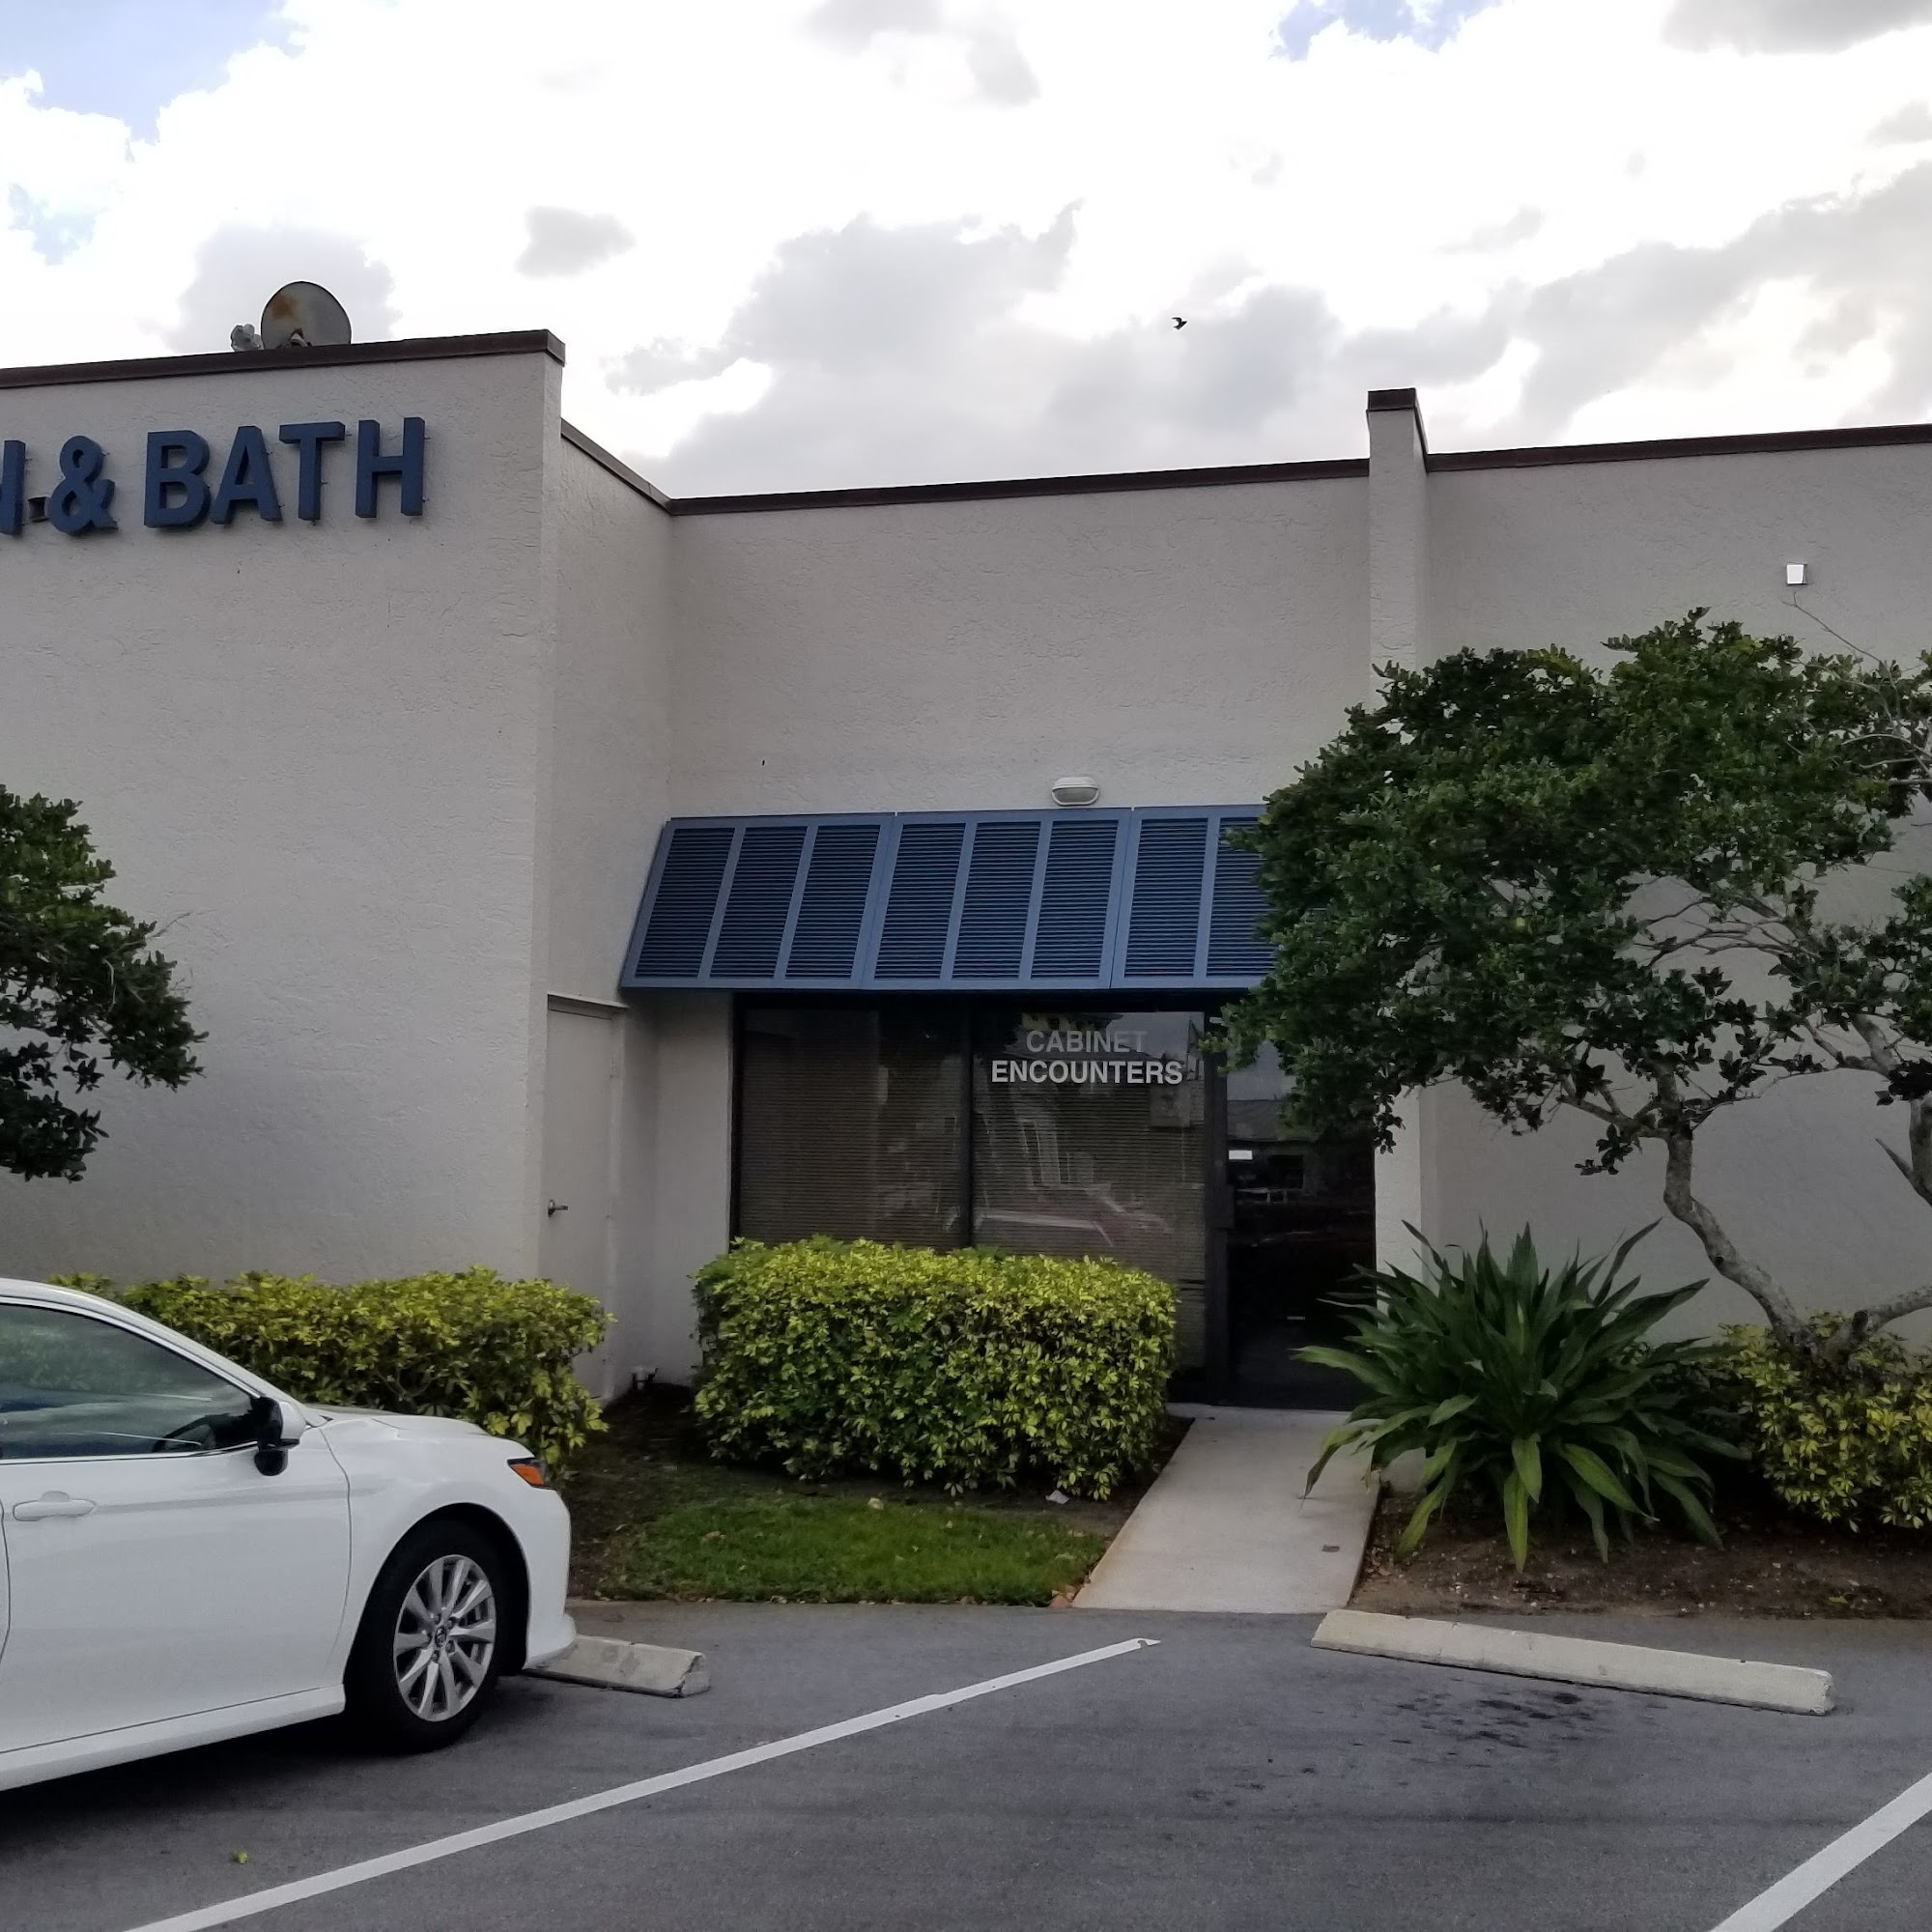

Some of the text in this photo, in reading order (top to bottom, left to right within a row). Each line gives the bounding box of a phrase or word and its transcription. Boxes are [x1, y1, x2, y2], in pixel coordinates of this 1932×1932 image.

[47, 436, 118, 534] &
[144, 416, 425, 528] BATH
[1026, 1030, 1148, 1053] CABINET
[991, 1060, 1183, 1085] ENCOUNTERS
